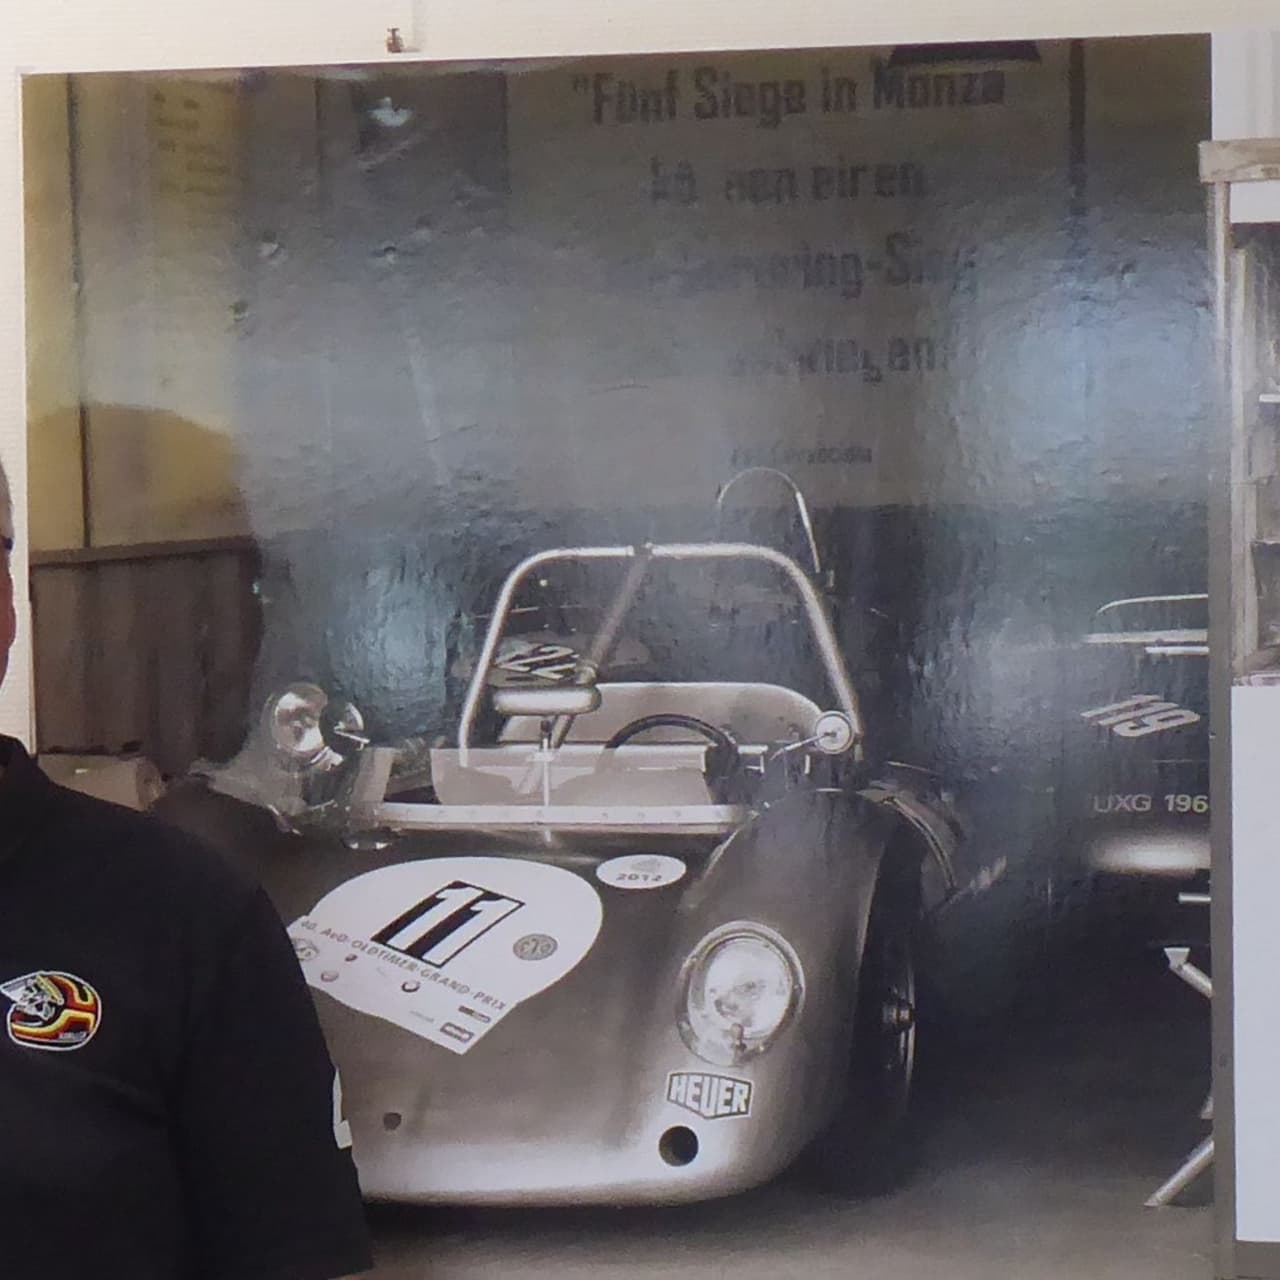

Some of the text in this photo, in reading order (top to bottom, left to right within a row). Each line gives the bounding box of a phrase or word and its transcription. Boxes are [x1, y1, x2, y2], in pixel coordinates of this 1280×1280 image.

[694, 66, 807, 128] Siege
[822, 66, 857, 114] in
[1093, 794, 1209, 813] UXG 196
[616, 873, 663, 883] 2012
[670, 1074, 748, 1117] HEUER
